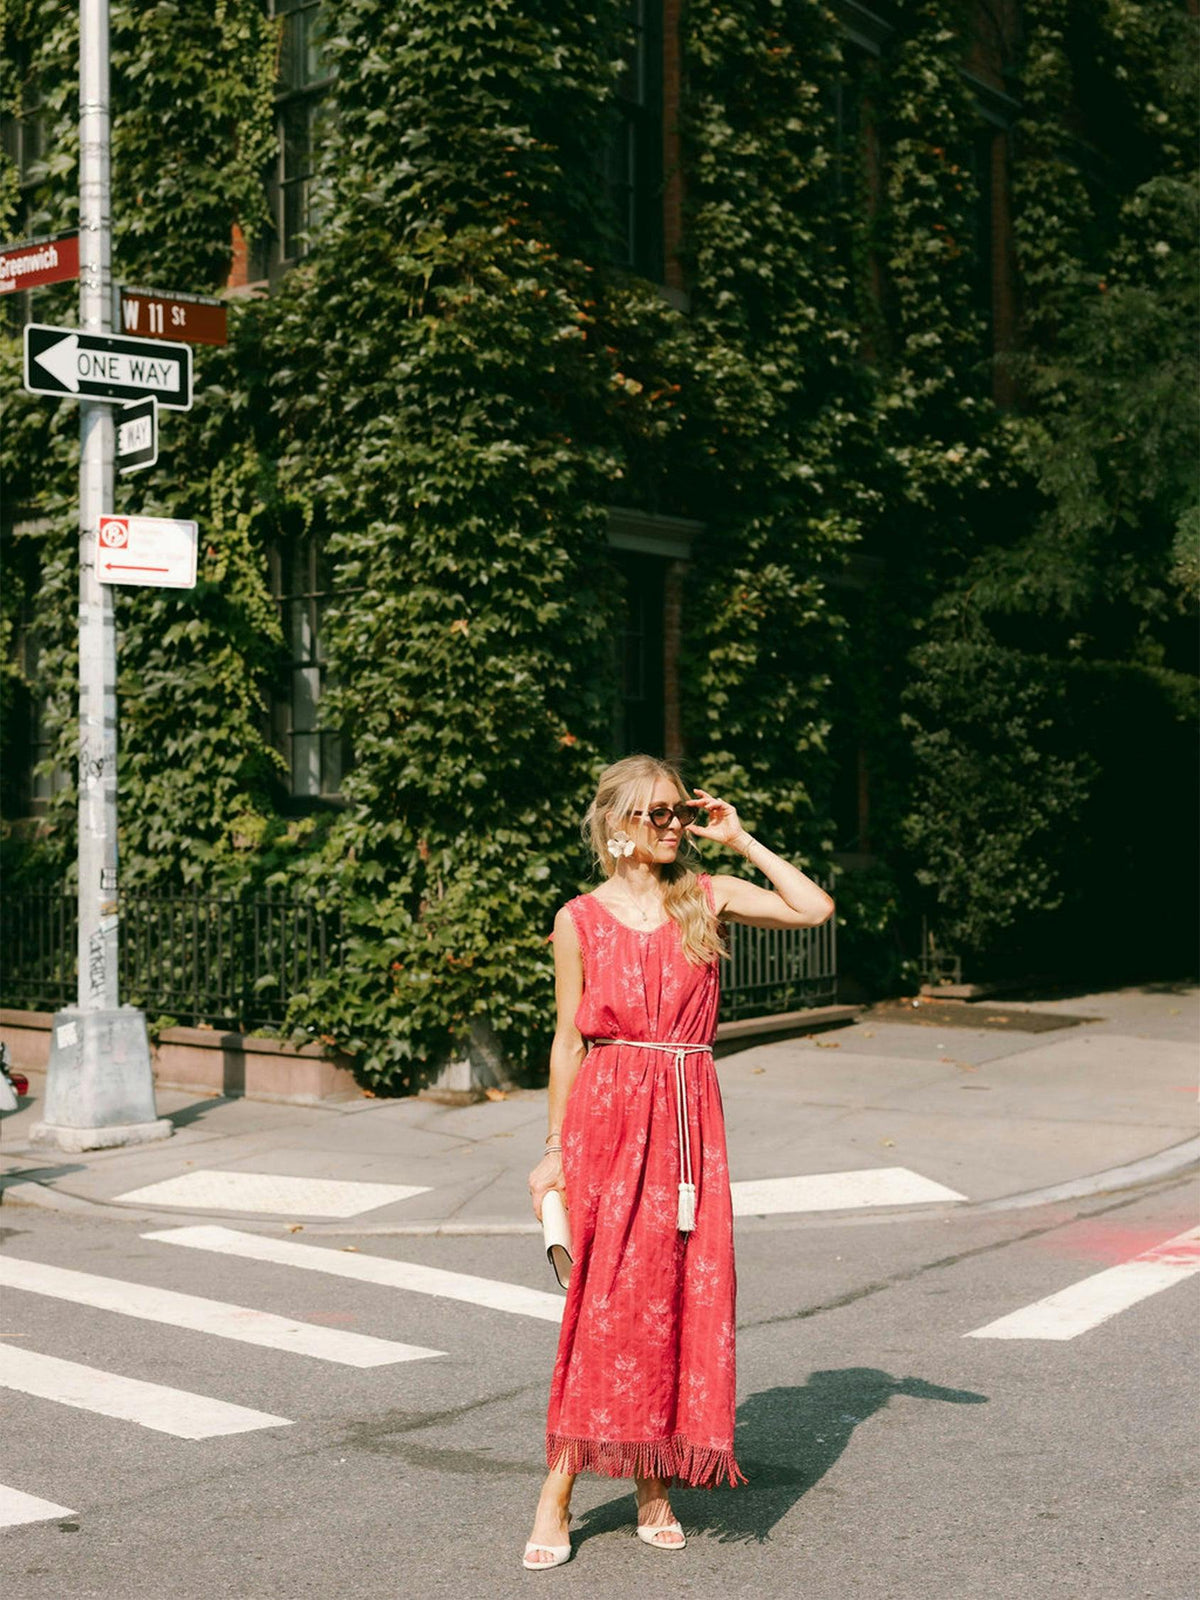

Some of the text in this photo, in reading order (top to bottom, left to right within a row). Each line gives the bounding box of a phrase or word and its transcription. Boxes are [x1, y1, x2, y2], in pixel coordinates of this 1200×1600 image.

[123, 299, 186, 333] W 11 St
[78, 353, 172, 386] ONE WAY
